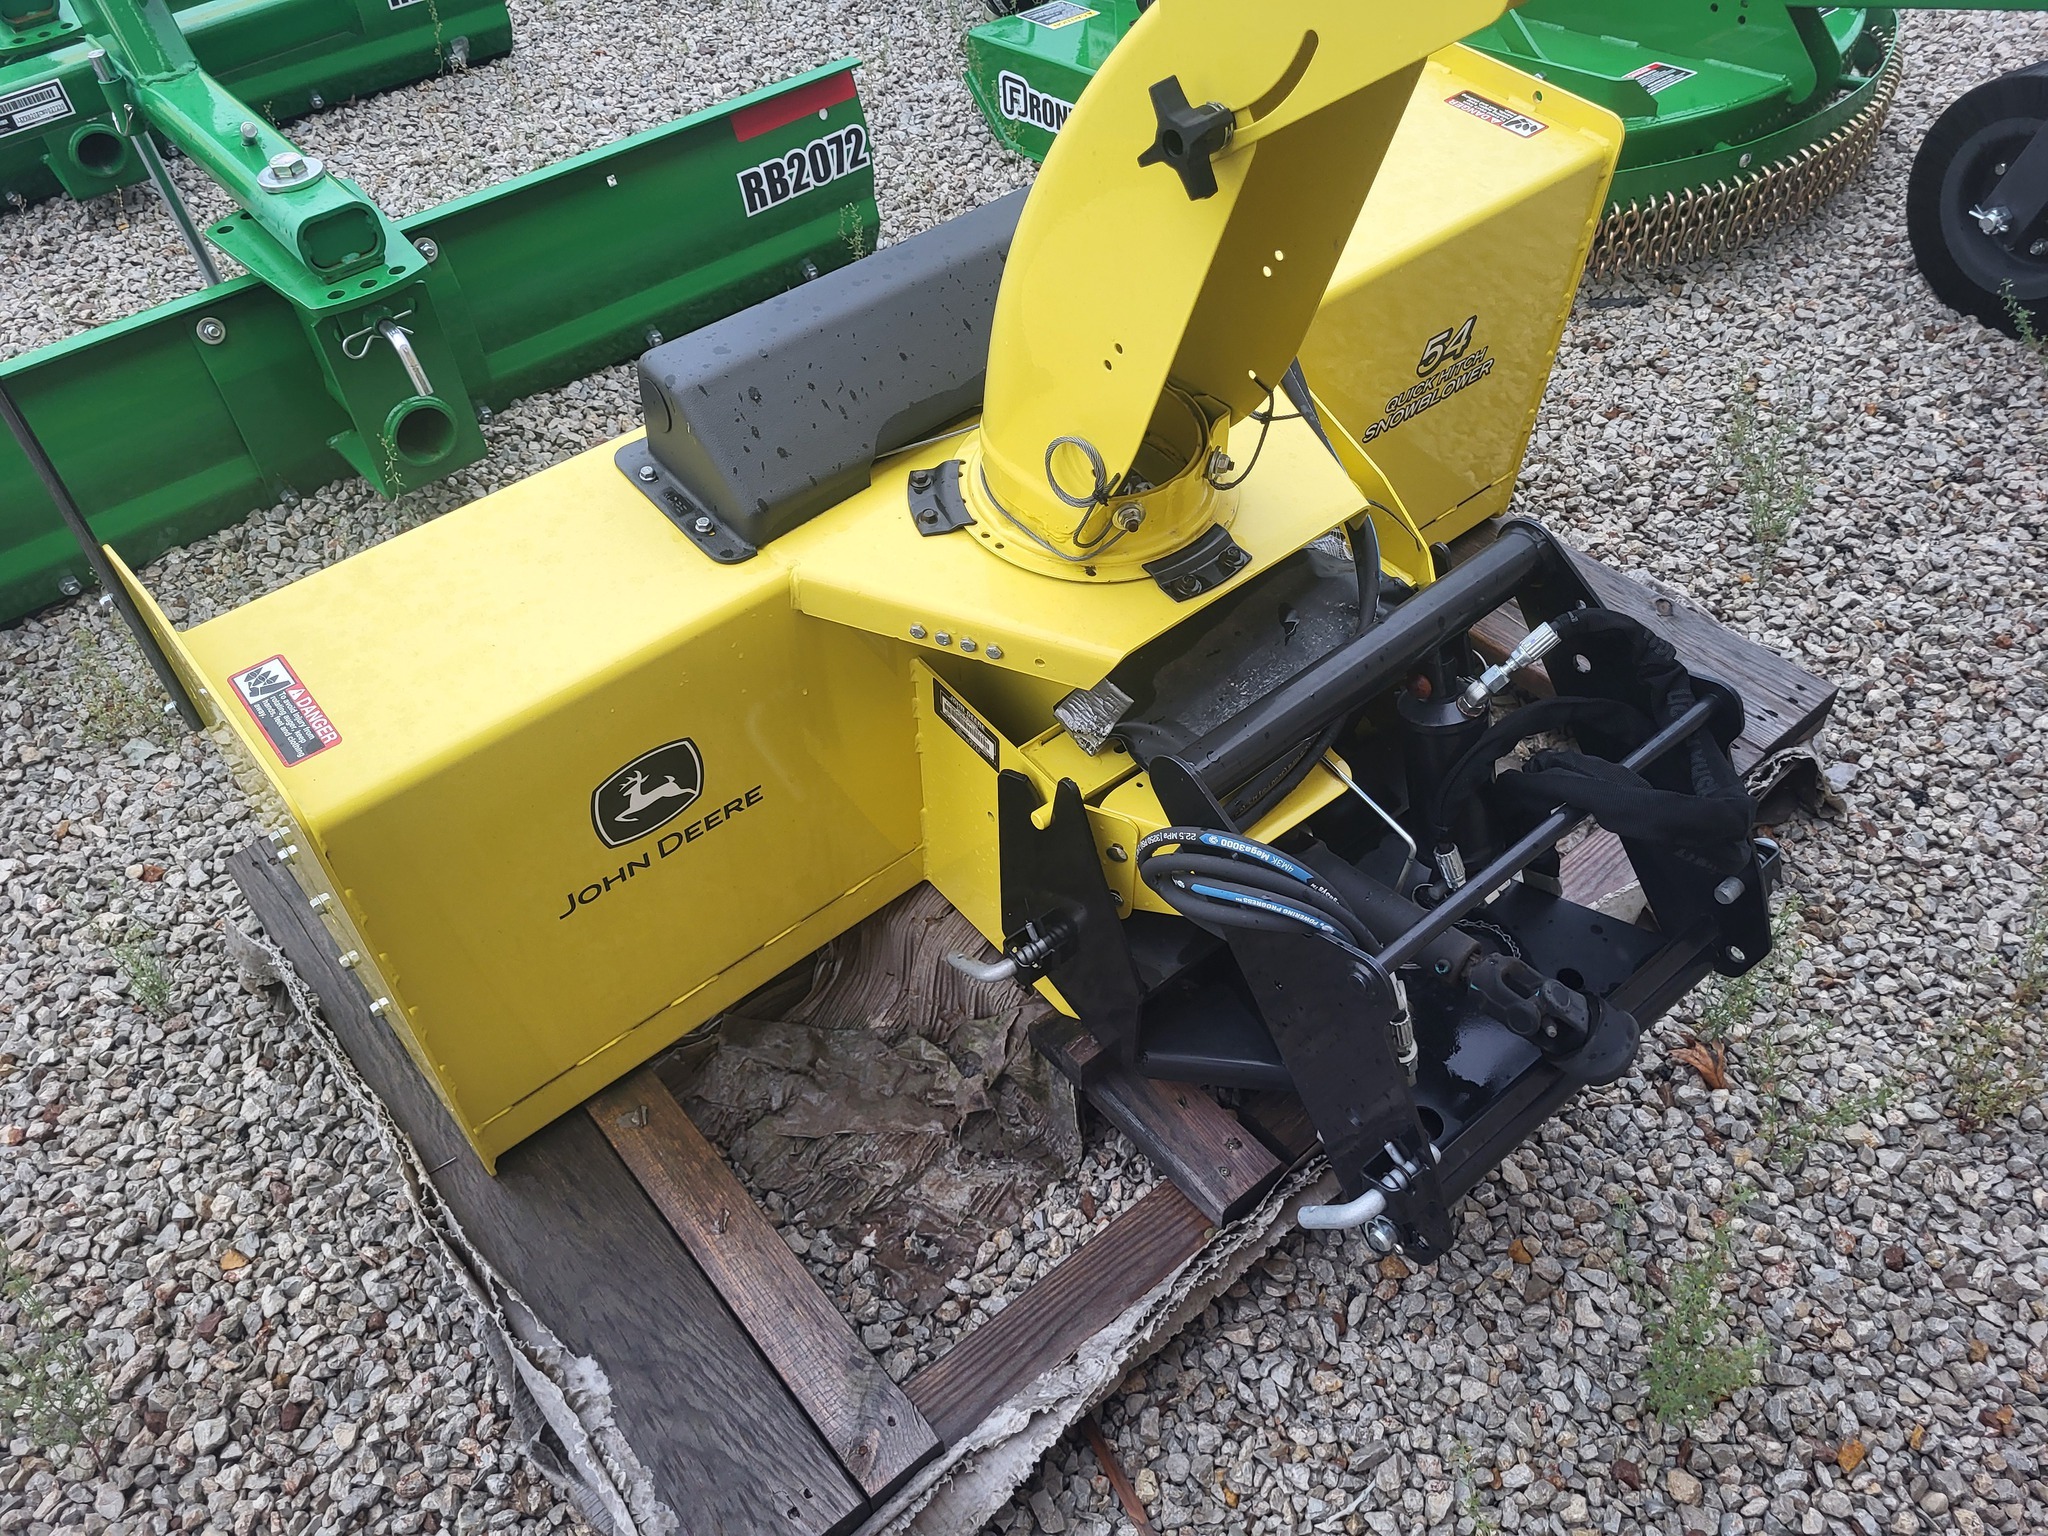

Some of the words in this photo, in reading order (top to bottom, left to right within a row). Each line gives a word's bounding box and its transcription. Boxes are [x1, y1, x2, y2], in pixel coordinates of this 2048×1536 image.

[1448, 99, 1490, 120] DANGER
[739, 126, 869, 214] RB2072
[1416, 314, 1478, 378] 54
[1384, 372, 1440, 413] QUICK
[1436, 345, 1489, 386] HITCH
[1362, 358, 1495, 443] SNOWBLOWER
[278, 690, 287, 700] To
[253, 703, 267, 719] away.
[282, 699, 297, 714] avoid
[261, 698, 276, 718] hands,
[273, 715, 285, 728] feet
[280, 725, 293, 737] and
[287, 735, 305, 758] clothing
[270, 695, 287, 716] rotating
[283, 714, 298, 732] auger,
[293, 729, 307, 744] keep
[292, 711, 307, 728] injury
[296, 696, 338, 744] DANGER
[302, 726, 315, 741] from
[1163, 832, 1178, 841] MPa
[1178, 831, 1197, 841] 22.5
[559, 852, 651, 920] JOHN
[657, 784, 764, 859] DEERE
[1220, 838, 1270, 861] Mega3000
[1271, 856, 1294, 873] 4M3K
[1282, 908, 1319, 926] POWERING
